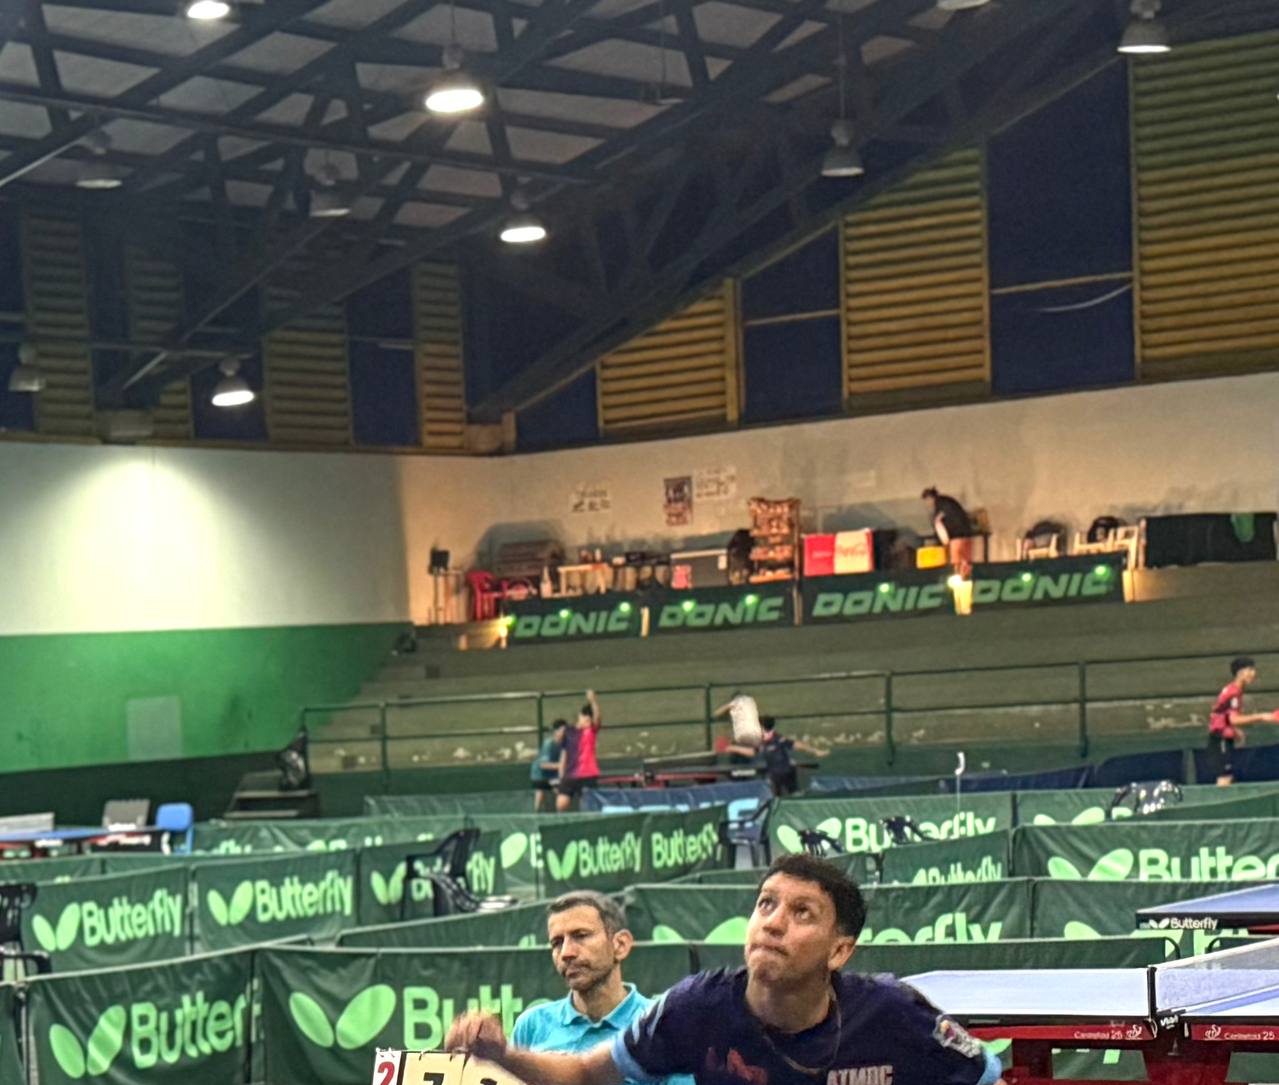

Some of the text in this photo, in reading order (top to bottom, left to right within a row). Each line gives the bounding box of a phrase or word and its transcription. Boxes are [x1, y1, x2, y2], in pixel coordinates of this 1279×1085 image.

[812, 584, 945, 617] DONIC
[971, 572, 1115, 604] DONIC
[514, 608, 630, 638] DONIC
[658, 597, 784, 628] DONIC
[579, 831, 642, 878] Butterfly
[256, 869, 354, 923] Butterfly
[82, 888, 182, 947] Butterfly
[1170, 916, 1218, 931] Butterfly
